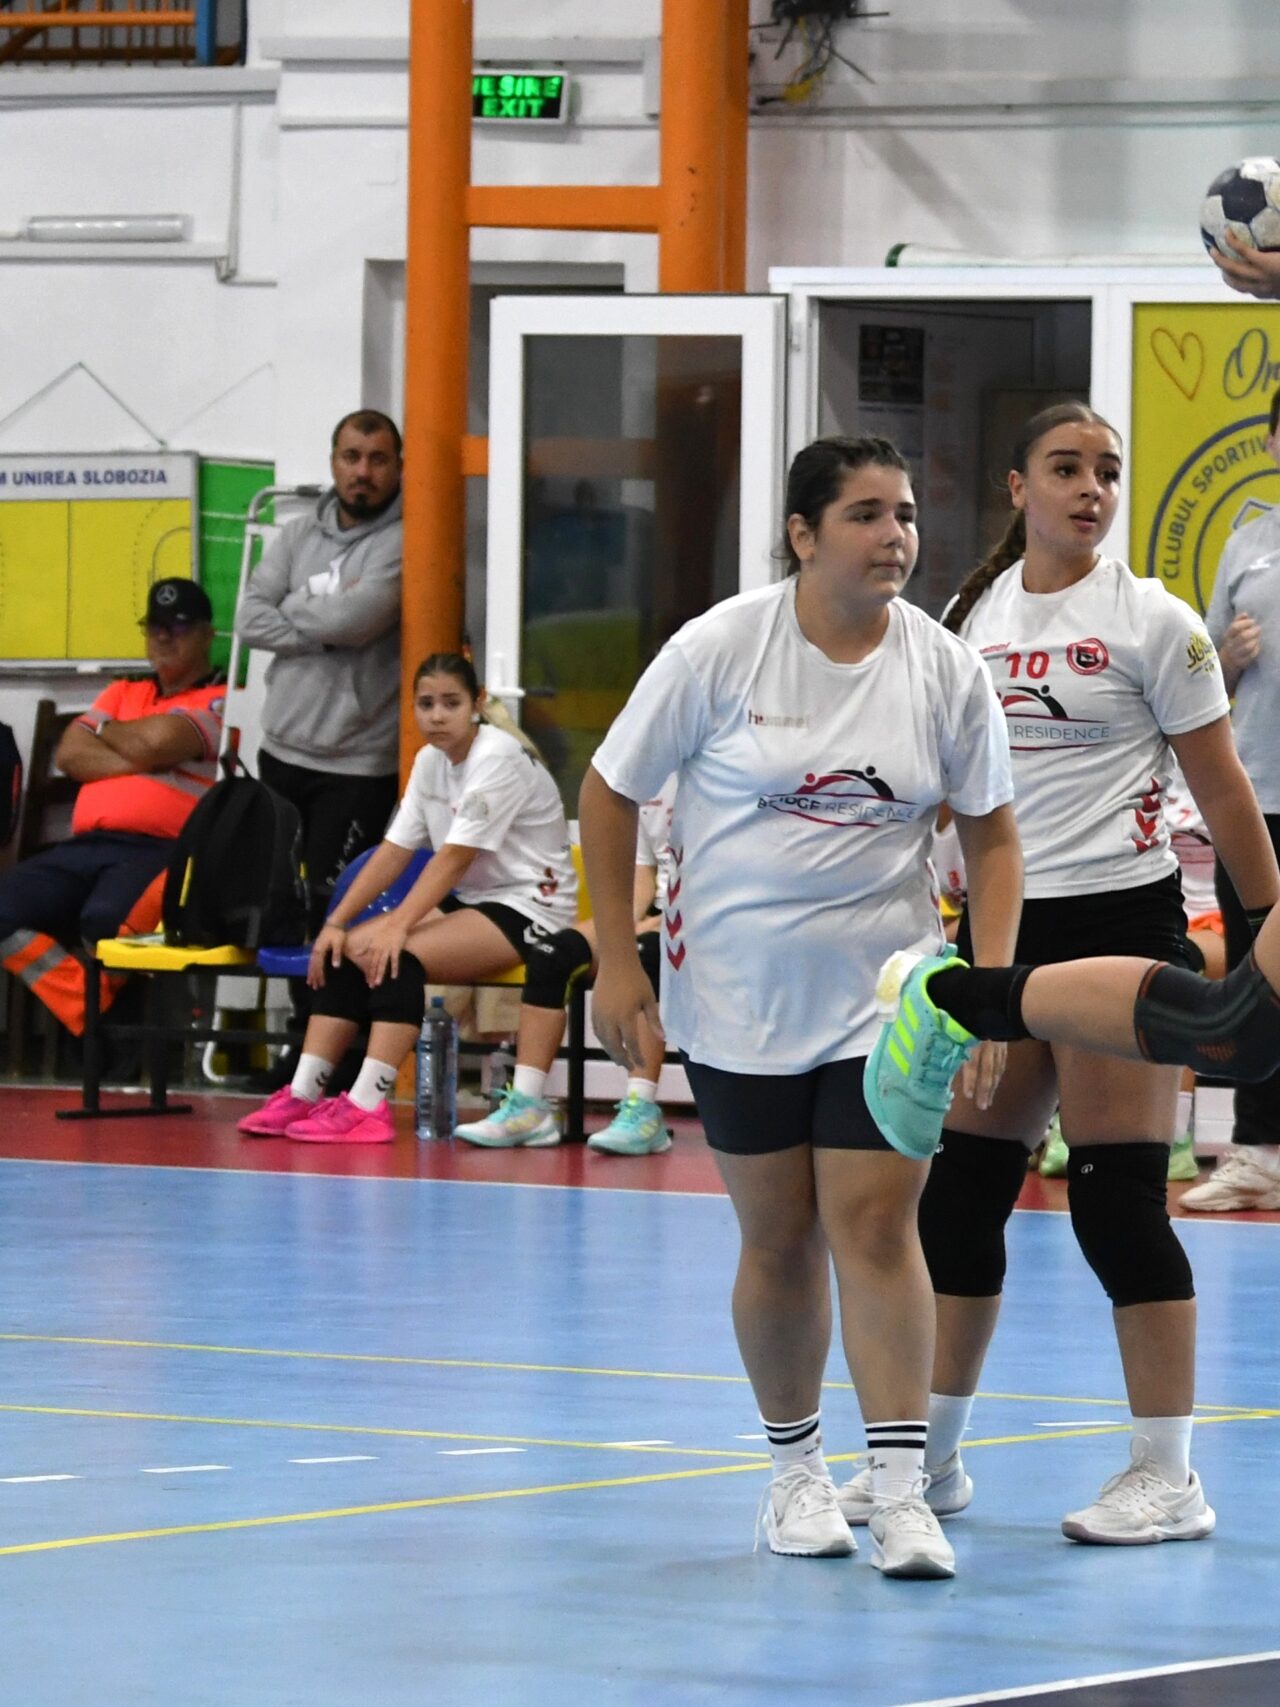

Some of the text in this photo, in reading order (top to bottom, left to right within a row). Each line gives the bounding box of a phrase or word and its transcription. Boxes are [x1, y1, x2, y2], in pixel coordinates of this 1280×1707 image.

[482, 98, 544, 118] EXIT
[12, 470, 77, 486] UNIREA
[82, 469, 168, 485] SLOBOZIA
[1163, 498, 1199, 580] CLUBUL
[1005, 651, 1050, 680] 10
[1013, 724, 1110, 741] RESIDENCE
